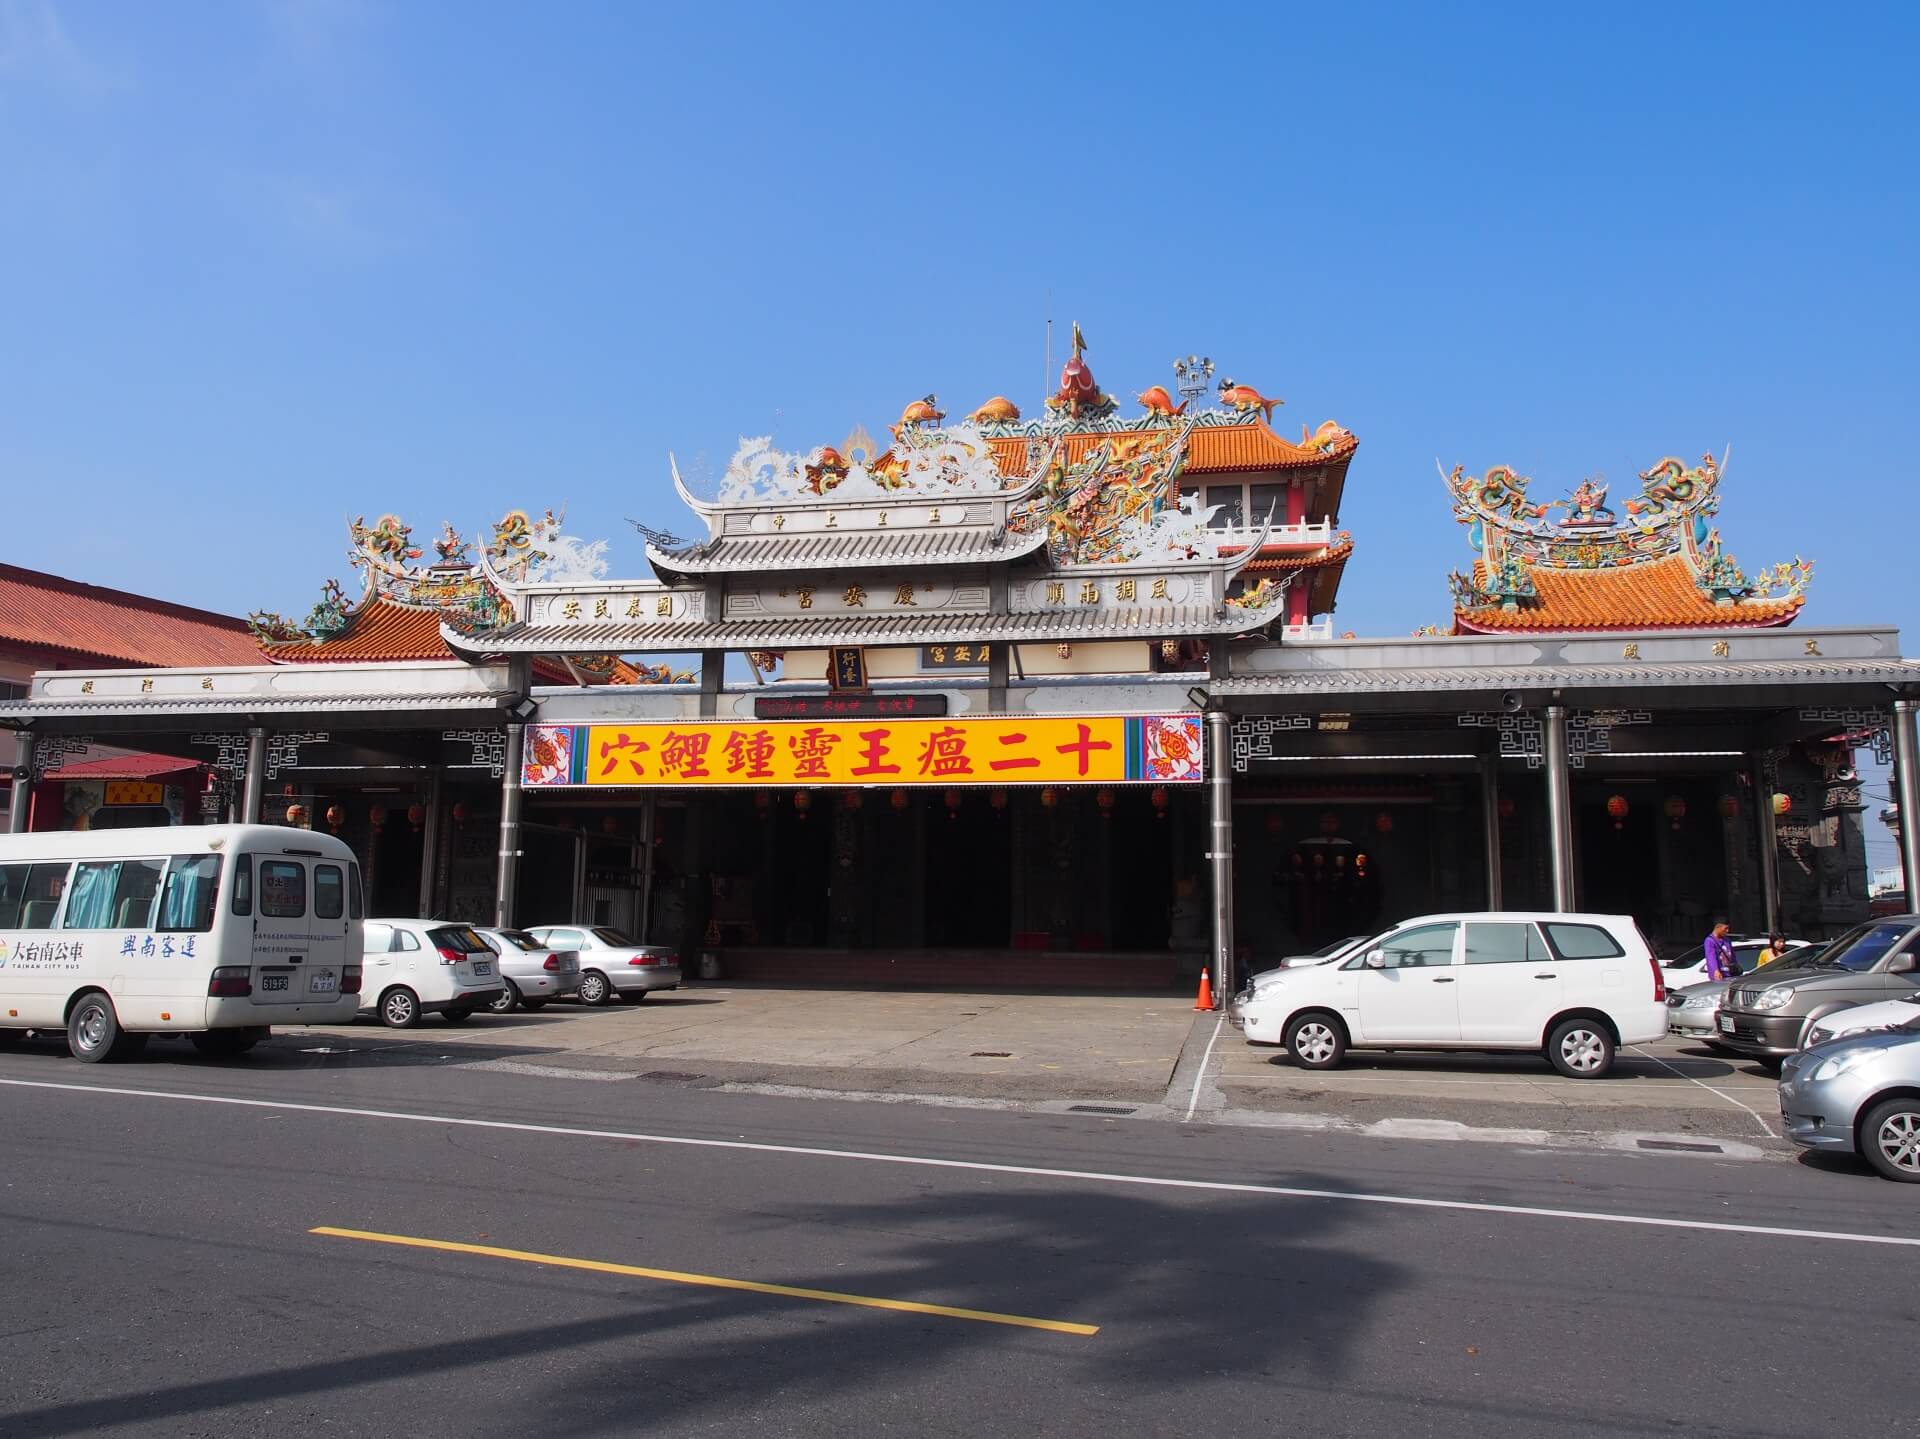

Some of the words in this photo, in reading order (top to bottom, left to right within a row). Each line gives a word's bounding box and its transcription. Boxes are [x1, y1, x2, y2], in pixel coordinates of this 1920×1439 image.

[1046, 576, 1172, 605] 風調雨順
[562, 594, 673, 619] 國泰民安
[12, 941, 84, 962] 大台南公車
[120, 935, 197, 958] 興南客運
